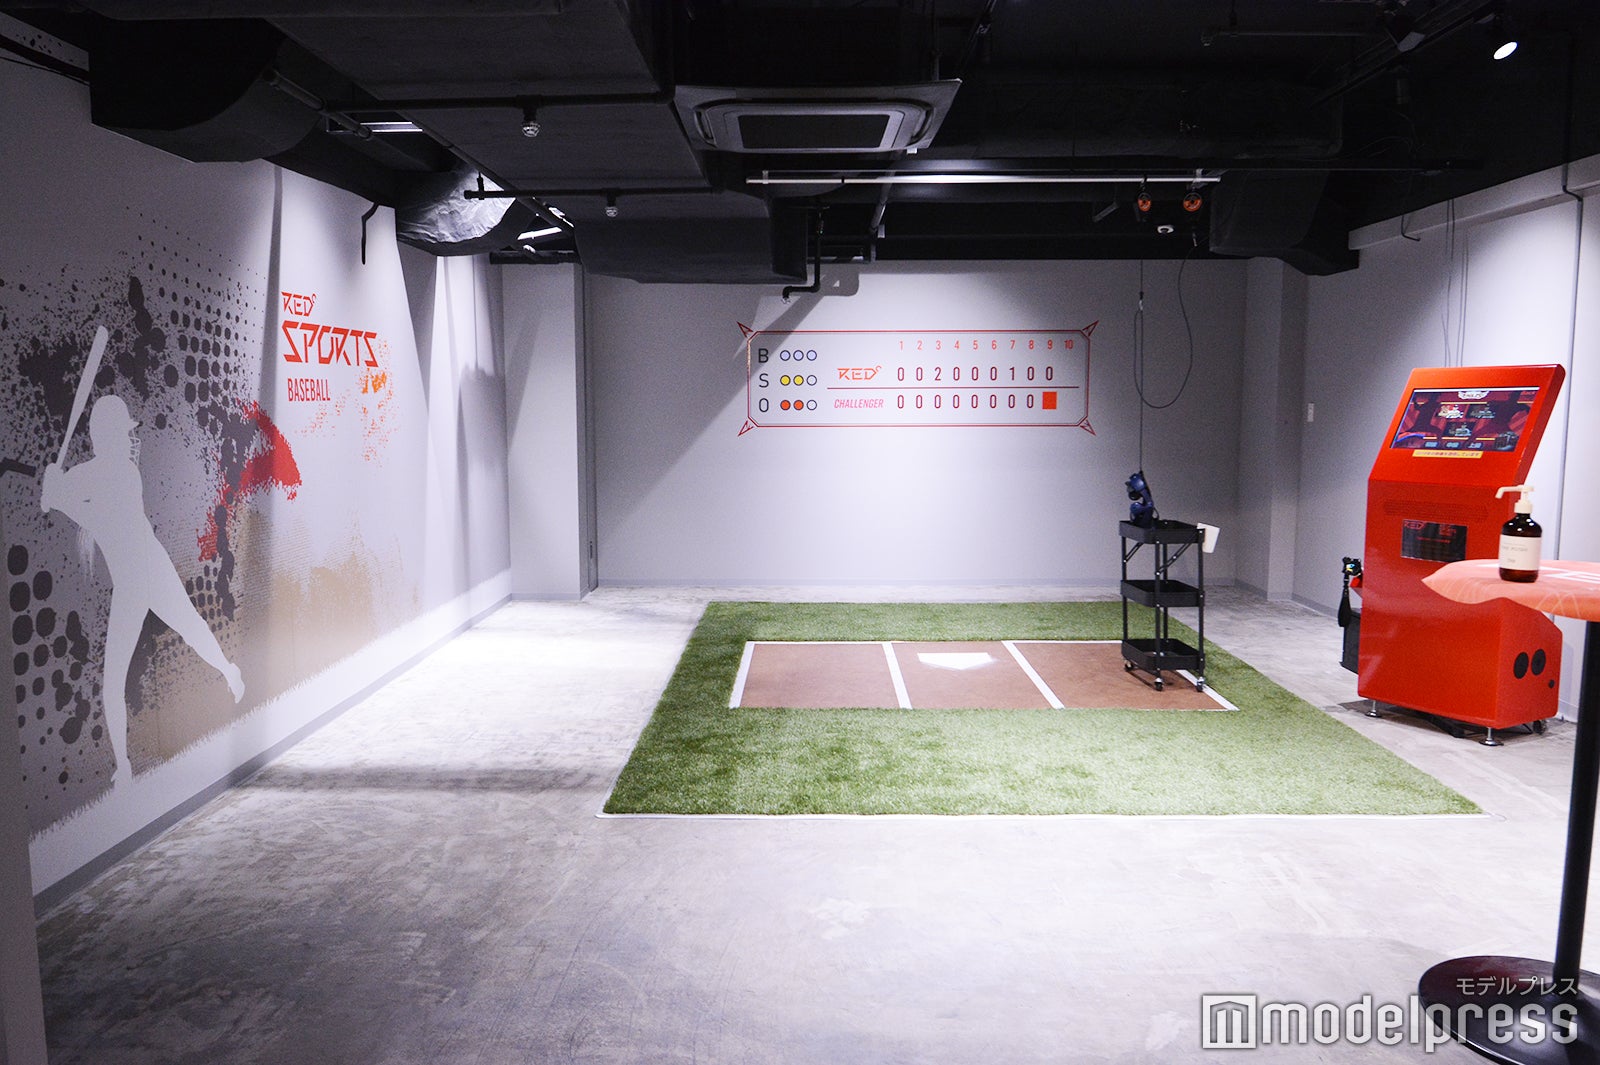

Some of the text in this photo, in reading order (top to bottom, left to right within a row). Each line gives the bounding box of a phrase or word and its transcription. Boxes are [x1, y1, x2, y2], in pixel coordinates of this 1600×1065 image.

[282, 320, 379, 367] SPORTS
[898, 340, 1074, 350] 1 2 3 4 5 6 7 8 9 10
[758, 348, 769, 363] B
[759, 373, 769, 388] S
[898, 367, 904, 381] 0
[916, 367, 923, 381] 0
[935, 367, 941, 381] 2
[953, 367, 960, 381] 0
[972, 367, 978, 381] 0
[990, 367, 997, 381] 0
[1009, 367, 1014, 380] 1
[1027, 367, 1034, 380] 0
[1046, 366, 1053, 381] 0
[287, 378, 331, 402] BASEBALL
[834, 394, 1034, 409] CHALLENGER 0 0 0 0 0 0 0 0
